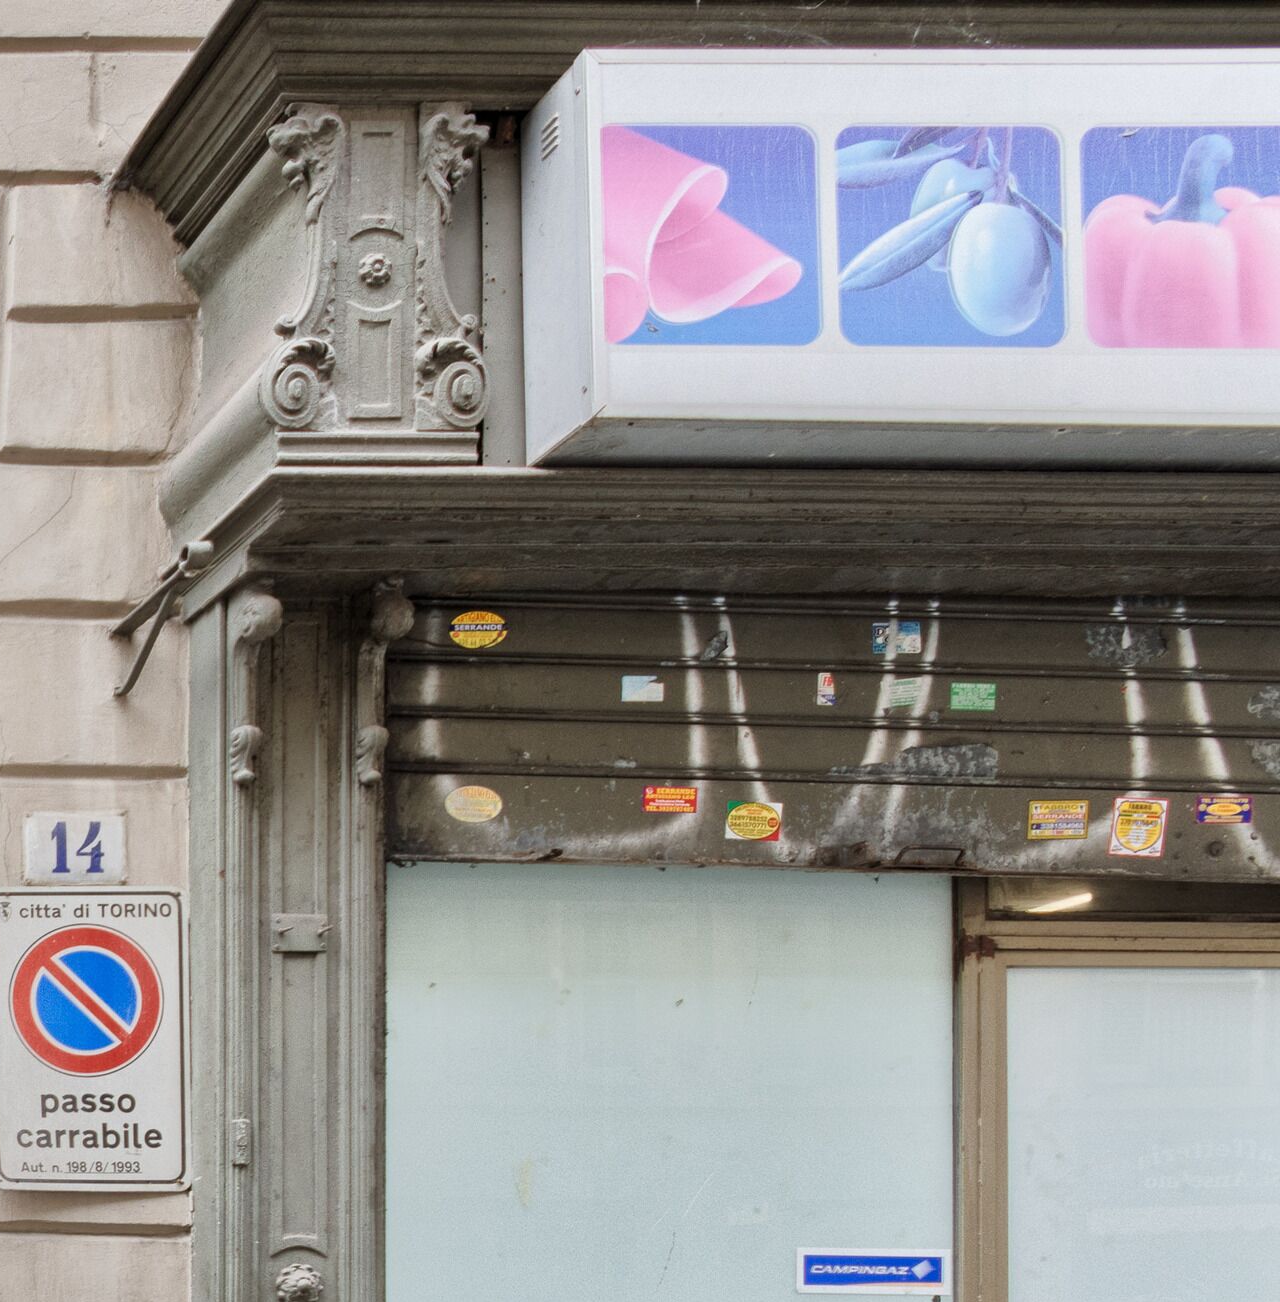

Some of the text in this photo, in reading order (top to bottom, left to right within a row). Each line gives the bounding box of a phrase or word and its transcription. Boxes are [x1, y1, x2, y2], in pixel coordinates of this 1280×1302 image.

[51, 821, 104, 873] 14
[19, 903, 172, 918] citta' di TORINO
[40, 1093, 136, 1118] passo
[16, 1122, 163, 1149] carrabile
[810, 1265, 910, 1275] CAMPINGAZ
